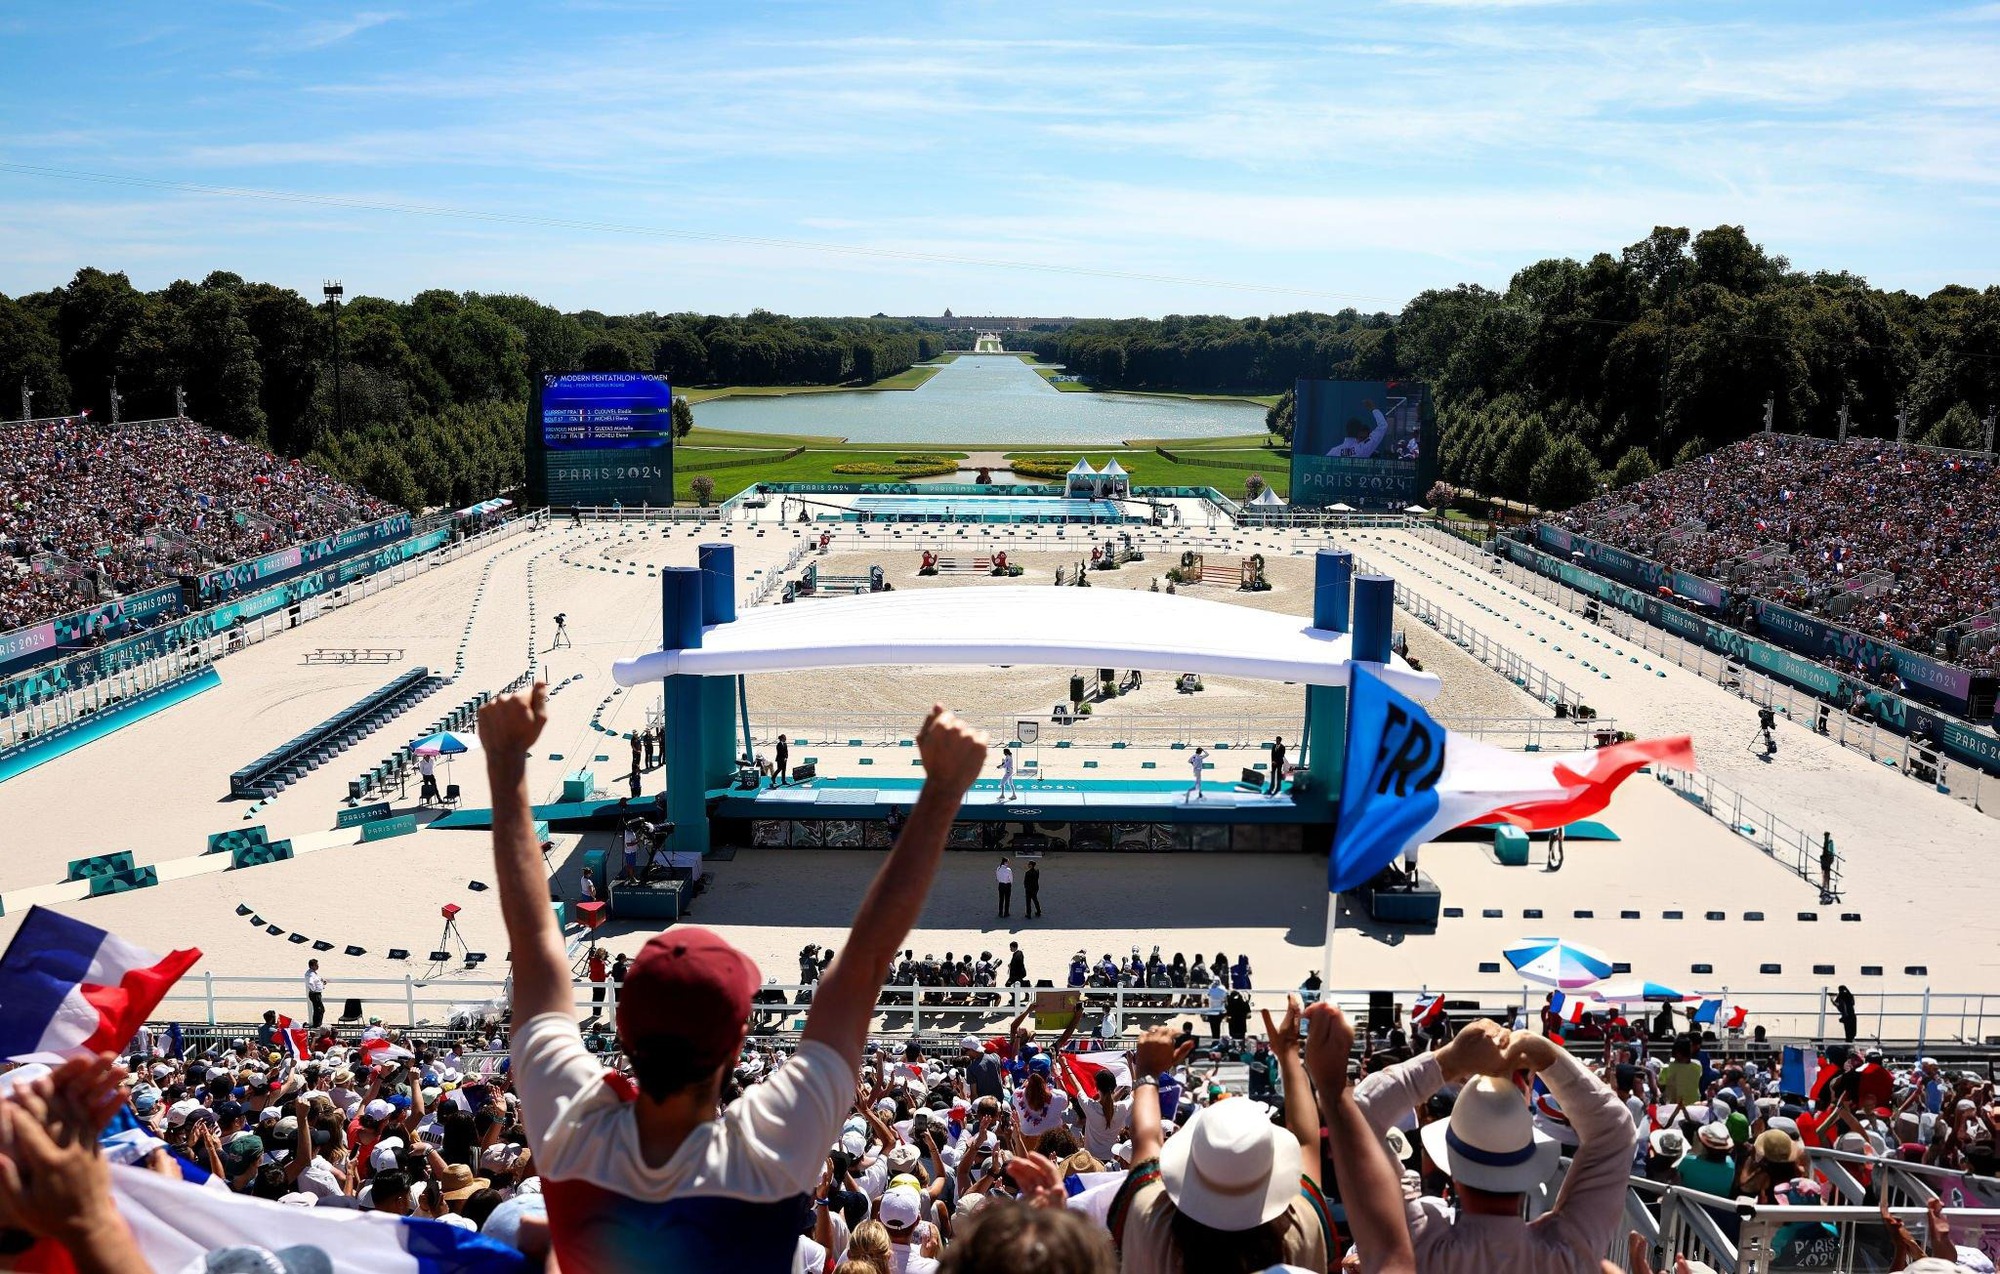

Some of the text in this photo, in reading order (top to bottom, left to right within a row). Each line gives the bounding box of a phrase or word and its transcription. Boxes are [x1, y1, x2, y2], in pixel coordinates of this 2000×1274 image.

[559, 466, 662, 480] PARIS 2024
[1304, 474, 1405, 490] PARIS 2024
[343, 531, 370, 545] PARIS 2024
[264, 555, 296, 571] PARIS 2024
[344, 562, 370, 576] PARIS 2024
[1681, 580, 1714, 600] PARIS 2024
[133, 593, 177, 614] PARIS 2024
[245, 596, 278, 613] PARIS 2024
[1668, 613, 1699, 632] PARIS 2024
[1772, 613, 1814, 637] PARIS 2024
[19, 633, 45, 650] 2024
[1786, 662, 1829, 687] PARIS 2024
[1898, 659, 1957, 689] PARIS 2024
[1956, 732, 1987, 754] PARIS
[343, 807, 388, 822] PARIS 2024
[367, 821, 412, 835] PARIS 2024
[420, 1131, 442, 1144] ITALIA
